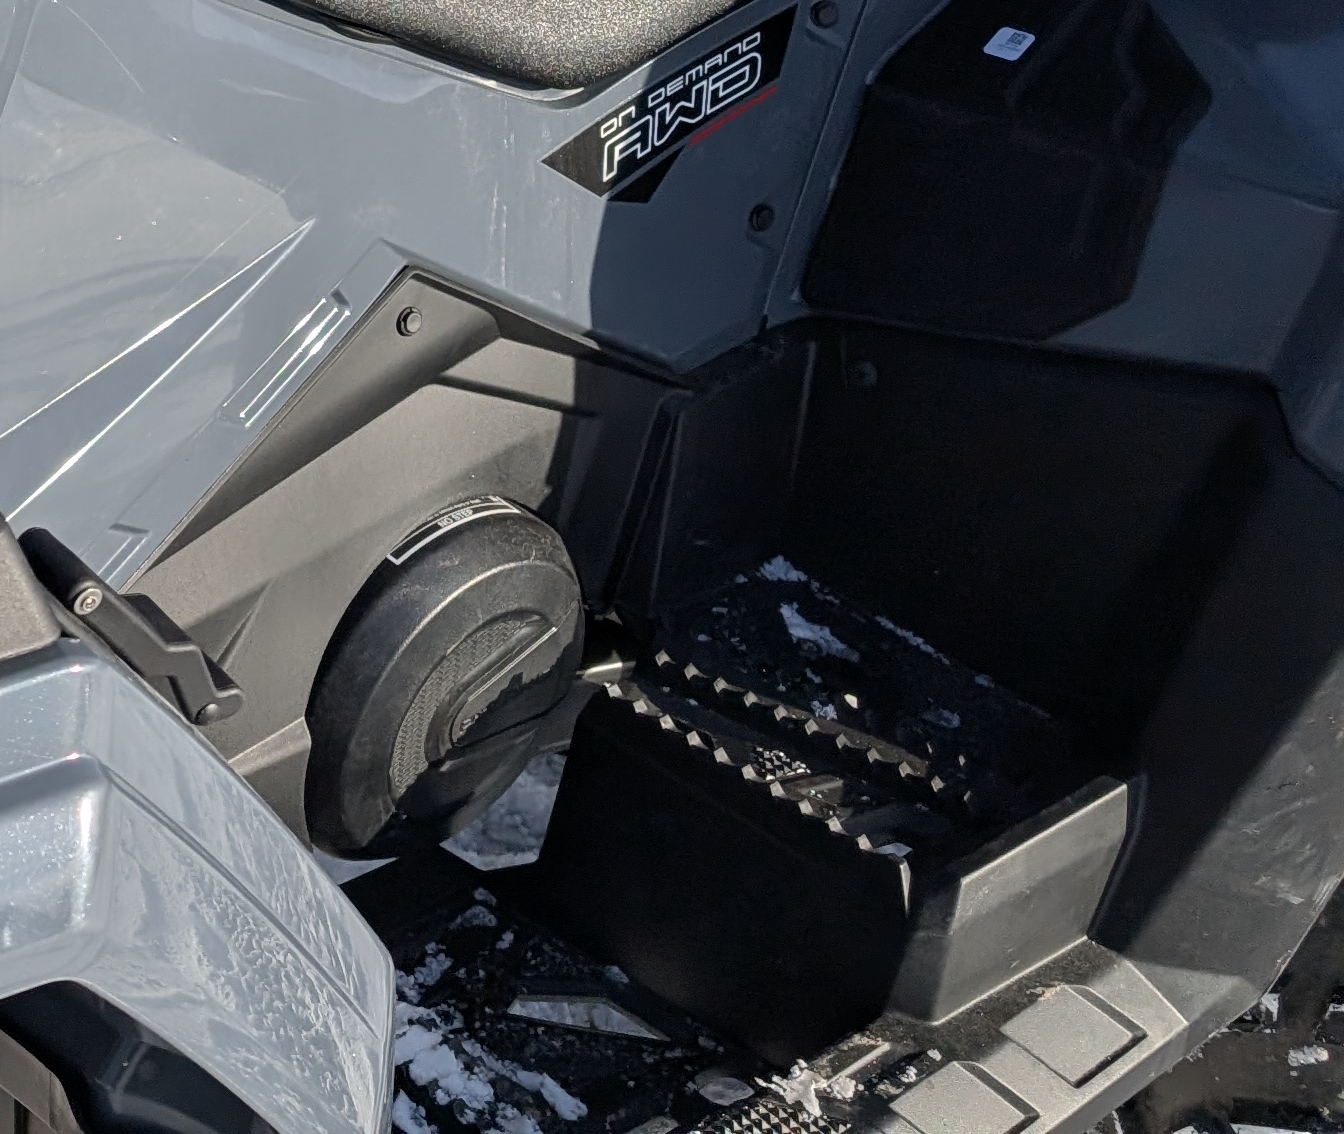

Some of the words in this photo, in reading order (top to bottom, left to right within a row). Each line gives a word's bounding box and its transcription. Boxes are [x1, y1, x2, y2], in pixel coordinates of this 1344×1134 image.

[600, 104, 636, 139] ON
[647, 31, 762, 107] DEMAND
[602, 51, 763, 183] AWD
[437, 517, 454, 528] NO
[451, 509, 474, 522] STEP
